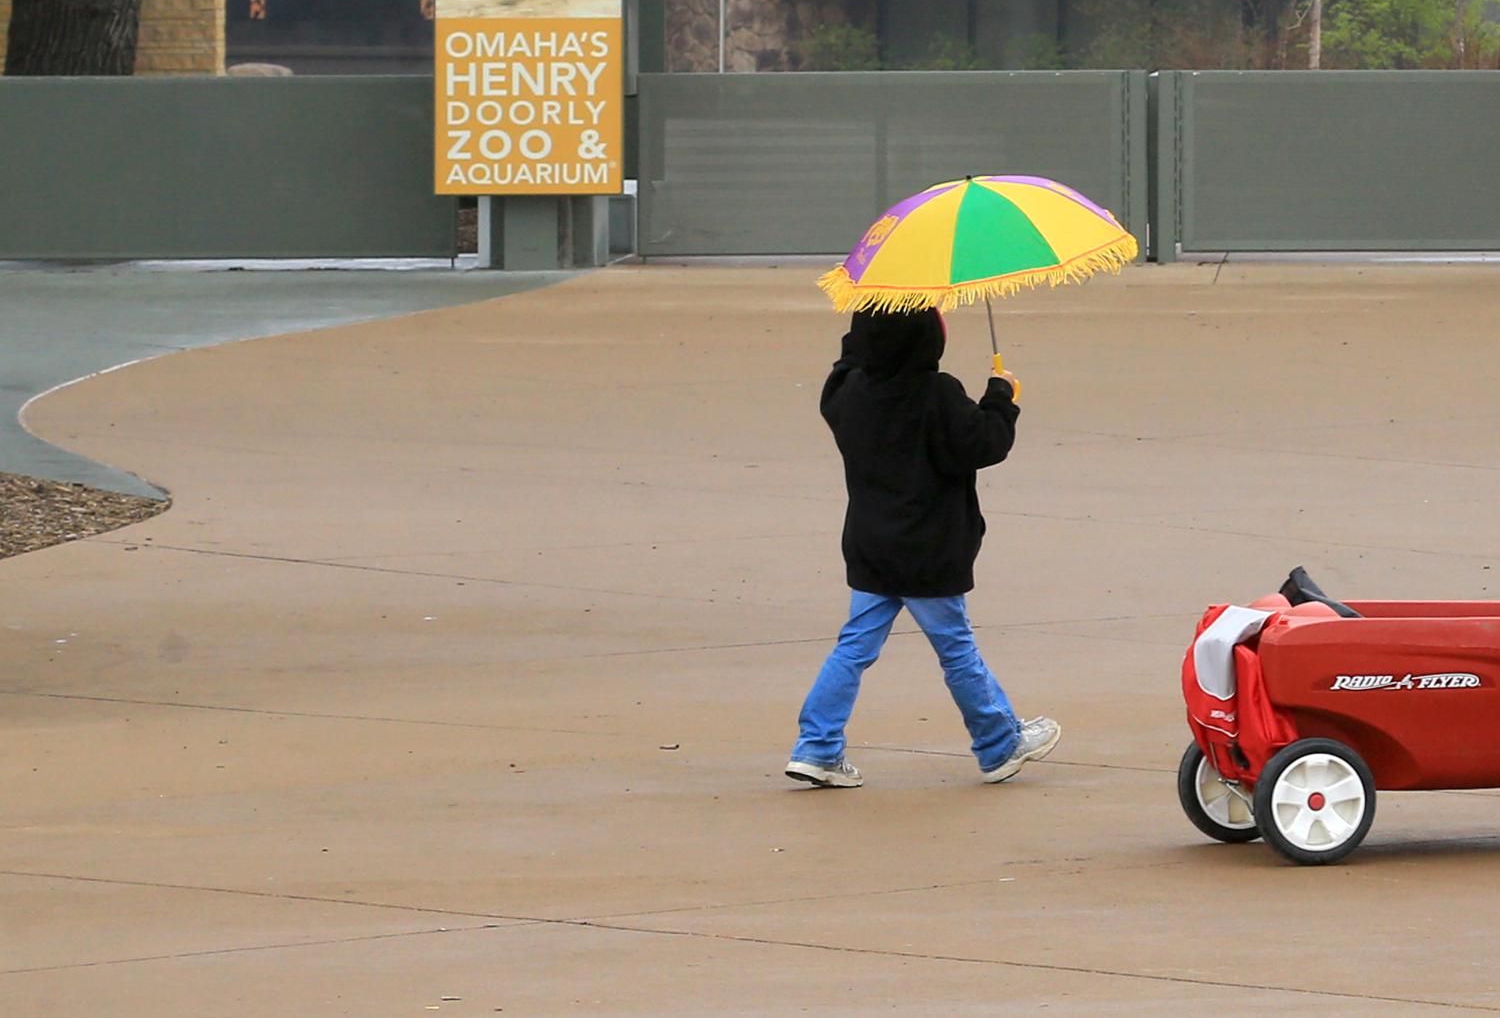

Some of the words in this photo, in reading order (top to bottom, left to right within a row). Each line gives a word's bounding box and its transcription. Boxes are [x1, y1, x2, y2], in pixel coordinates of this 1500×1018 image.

[445, 32, 609, 58] OMAHA'S
[446, 62, 607, 96] HENRY
[447, 101, 607, 125] DOORLY
[447, 129, 552, 160] ZOO
[577, 129, 607, 160] &
[1330, 675, 1396, 690] RADIO
[1414, 672, 1481, 689] FLYER
